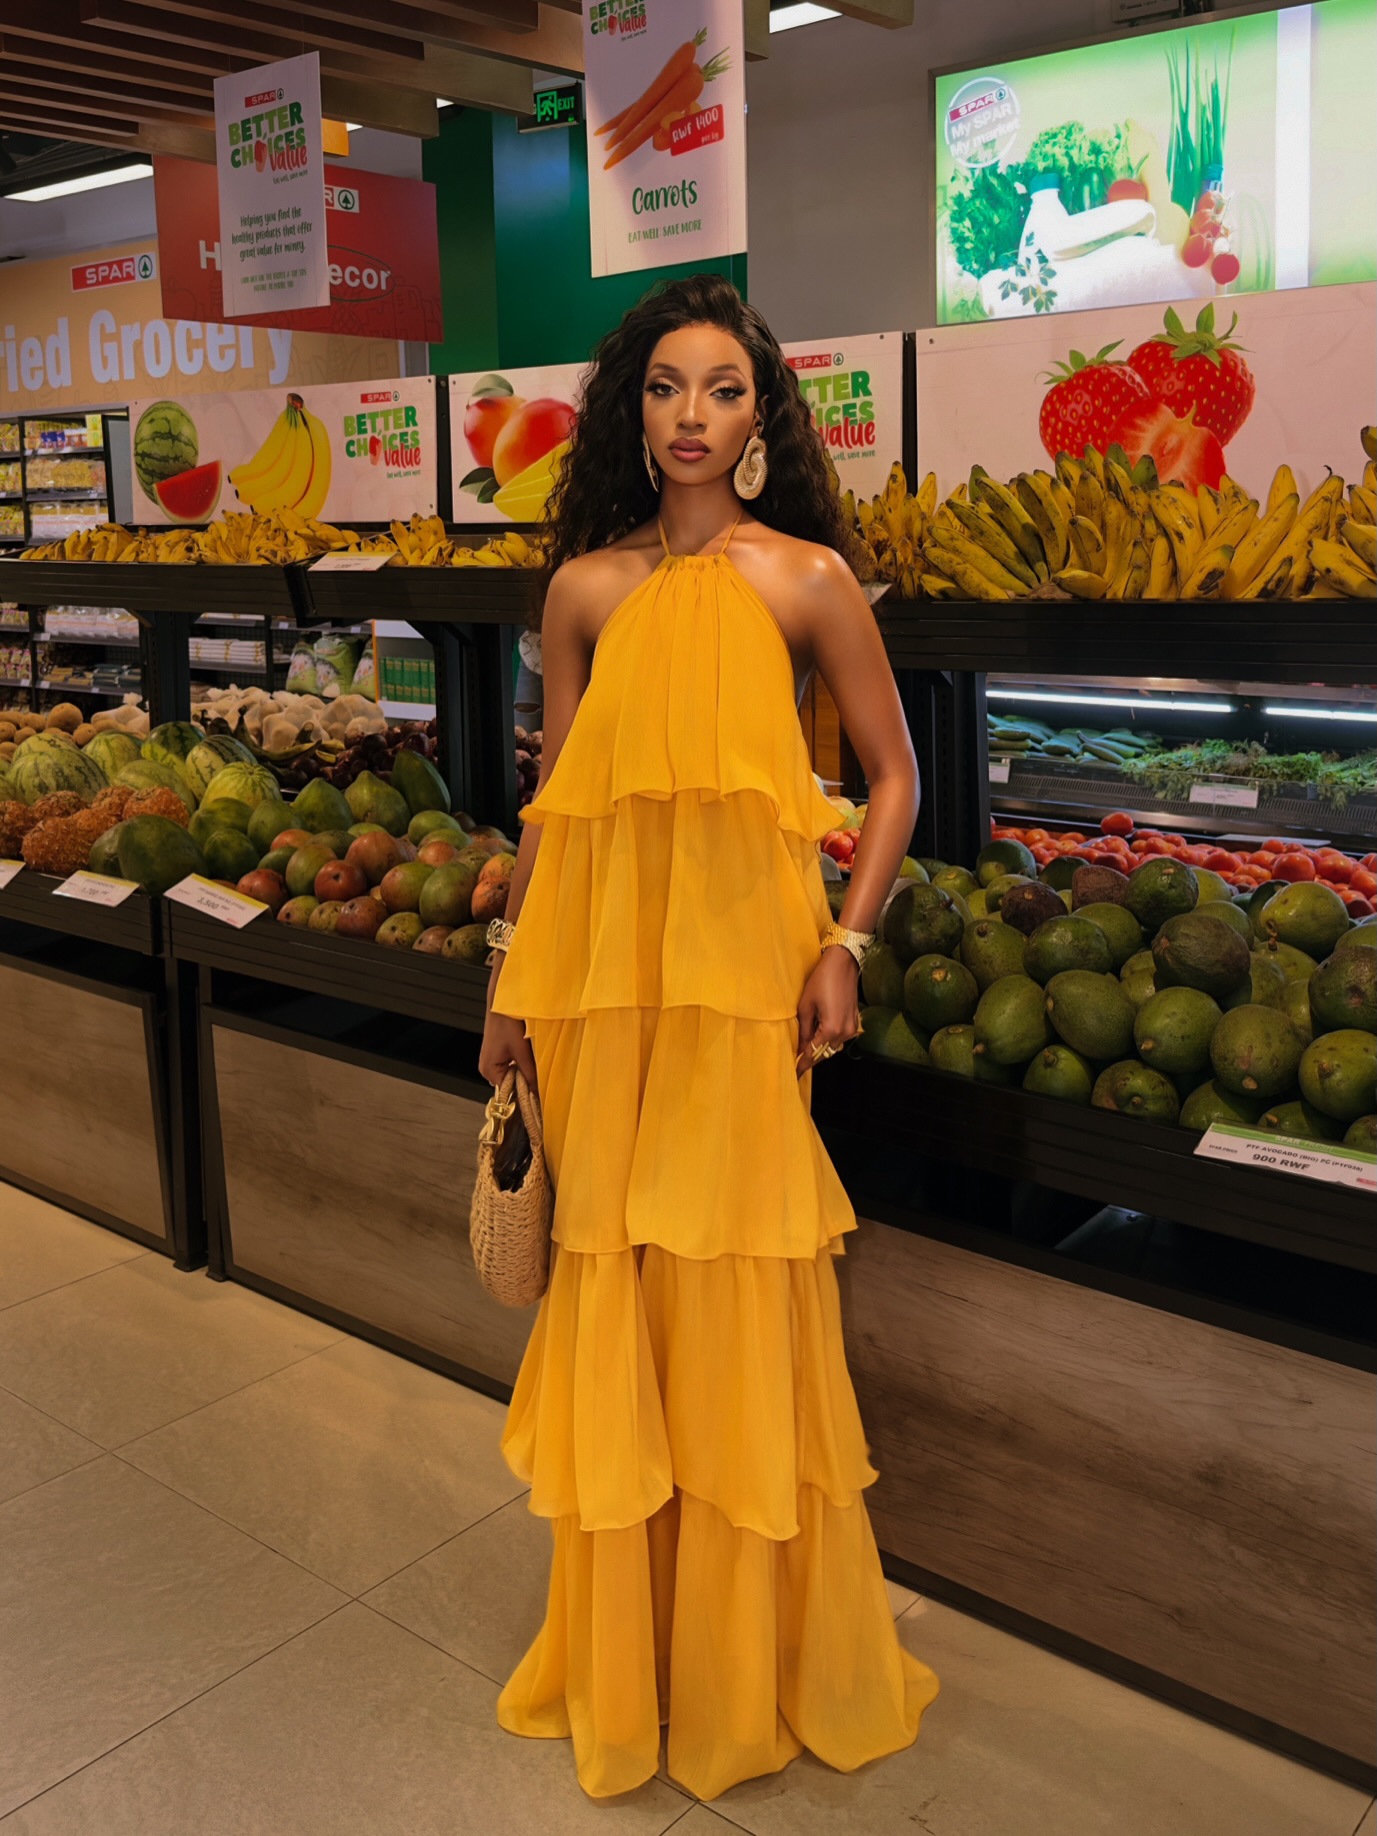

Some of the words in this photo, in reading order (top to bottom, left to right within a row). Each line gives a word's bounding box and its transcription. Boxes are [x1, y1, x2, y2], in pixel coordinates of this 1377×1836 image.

[252, 91, 276, 105] SPAR
[558, 96, 575, 111] EXIT
[958, 94, 994, 116] SPAR
[228, 101, 304, 146] BETTER
[695, 107, 719, 131] 1400
[951, 122, 971, 139] My
[973, 102, 1012, 129] SPAR
[632, 179, 698, 215] Carrots
[240, 214, 263, 228] Helping
[264, 212, 276, 226] you
[278, 207, 290, 222] find
[292, 206, 302, 219] the
[231, 232, 254, 245] healthy
[255, 227, 281, 244] products
[282, 224, 296, 237] that
[297, 221, 312, 235] offer
[628, 230, 641, 244] EAT
[662, 223, 679, 237] SAVE
[681, 219, 702, 233] MORE
[239, 247, 256, 262] great
[257, 244, 272, 256] value
[274, 242, 283, 255] for
[86, 261, 134, 285] SPAR
[328, 263, 392, 291] ecor
[0, 316, 72, 392] ied
[88, 309, 293, 385] Grocery
[794, 356, 831, 368] SPAR
[367, 393, 391, 402] SPAR
[798, 370, 873, 404] TTER
[343, 406, 418, 437] BETTER
[1274, 1135, 1300, 1146] SPAR
[1252, 1153, 1277, 1164] 900
[1279, 1159, 1311, 1170] RWF
[1261, 1146, 1298, 1158] AVOCADO
[1299, 1154, 1319, 1163] (BIG)
